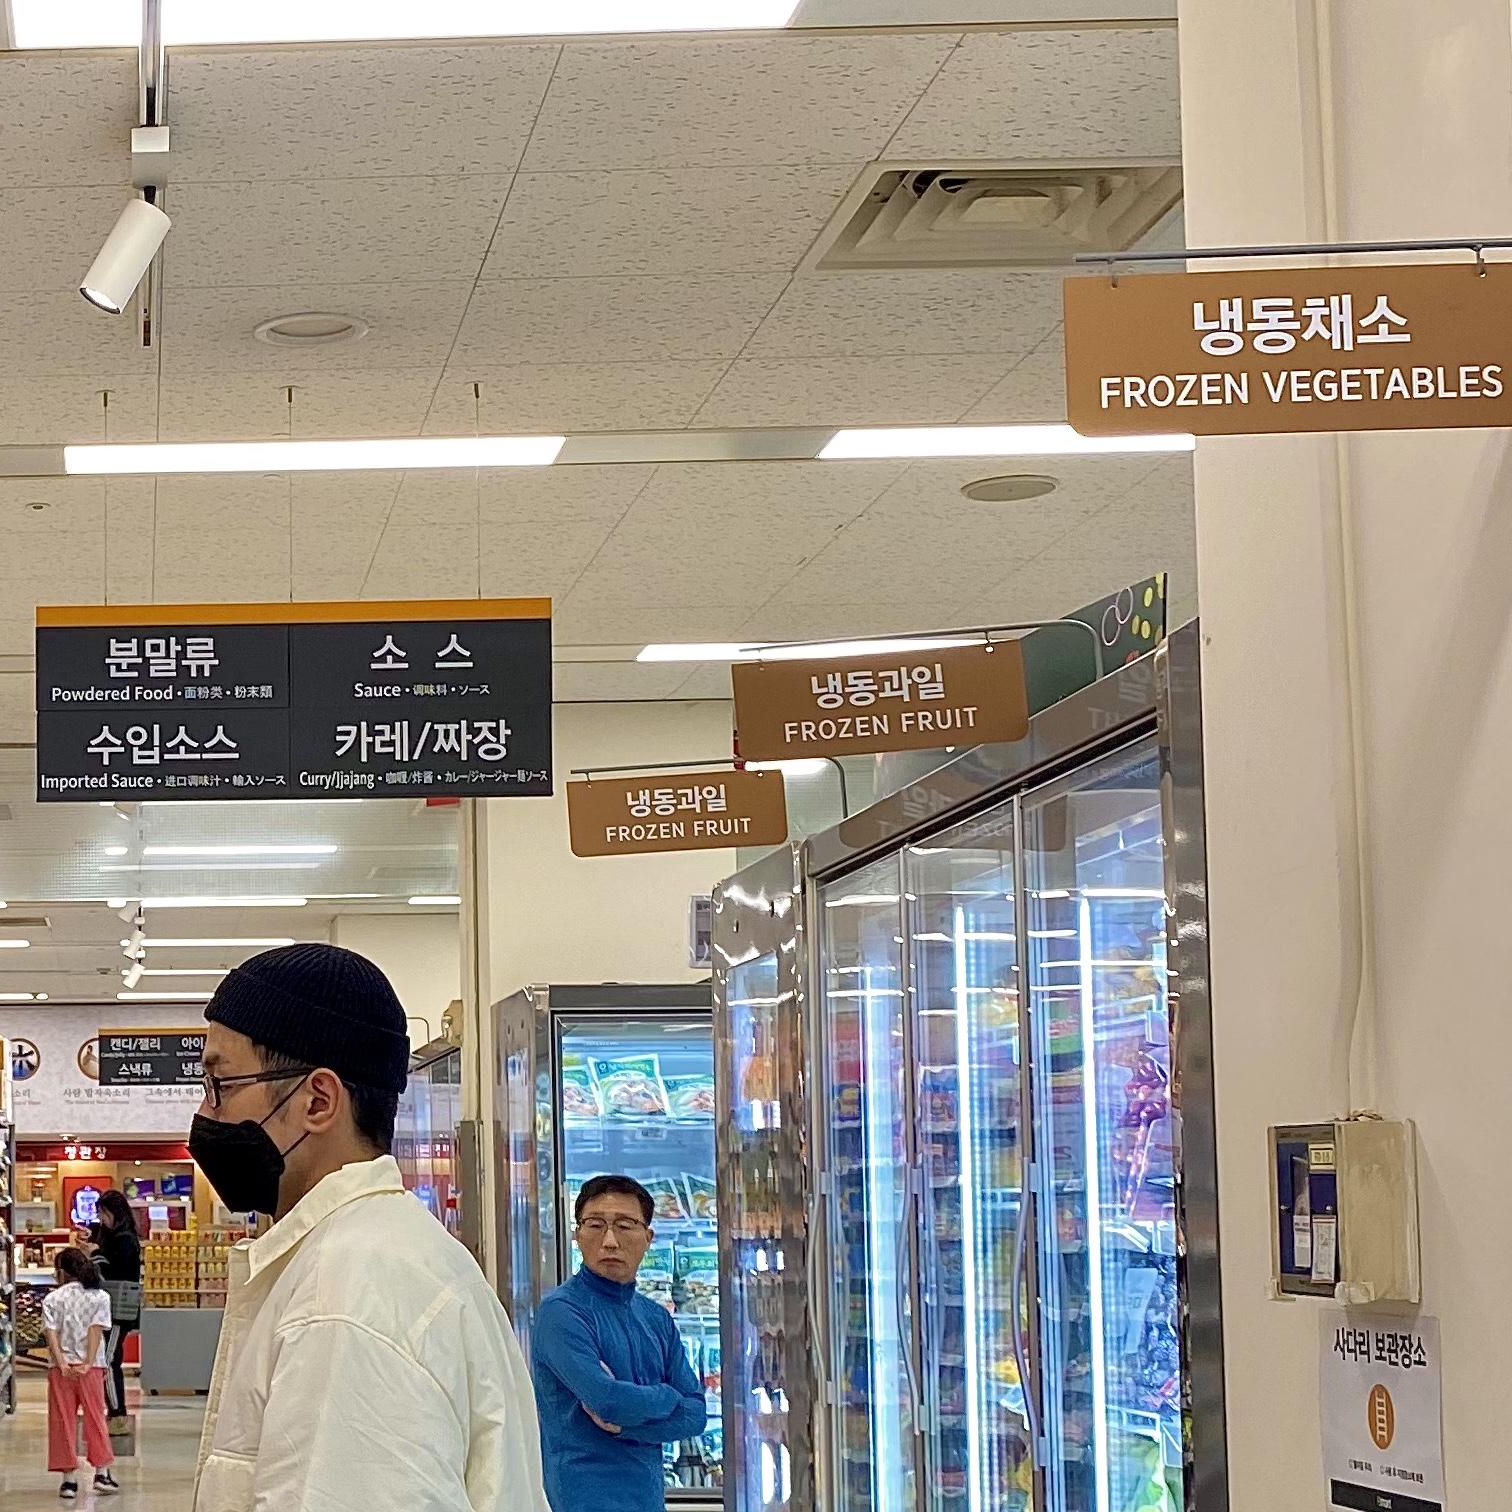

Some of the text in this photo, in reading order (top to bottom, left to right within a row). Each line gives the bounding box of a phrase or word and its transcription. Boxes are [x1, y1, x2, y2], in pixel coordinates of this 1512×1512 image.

[1192, 293, 1412, 356] 냉동채소
[1100, 364, 1504, 409] FROZEN VEGETABLES
[104, 636, 220, 679] 분말류
[51, 685, 131, 703] Powdered
[134, 685, 174, 701] Food
[353, 682, 402, 698] Sauce
[458, 684, 491, 697] ソース
[809, 663, 947, 710] 냉동과일
[334, 718, 513, 762] 카레/짜장
[783, 706, 979, 744] FROZEN FRUIT
[87, 724, 241, 766] 수입소스
[40, 773, 108, 792] Imported
[111, 773, 154, 788] Sauce
[299, 771, 375, 790] Curry/Jjajang
[626, 784, 728, 816] 냉동과일
[604, 816, 752, 844] FROZEN FRUIT
[117, 1062, 153, 1076] 스낵류
[64, 1146, 107, 1160] 정관장
[1334, 1326, 1427, 1369] 사다리 보관장소
